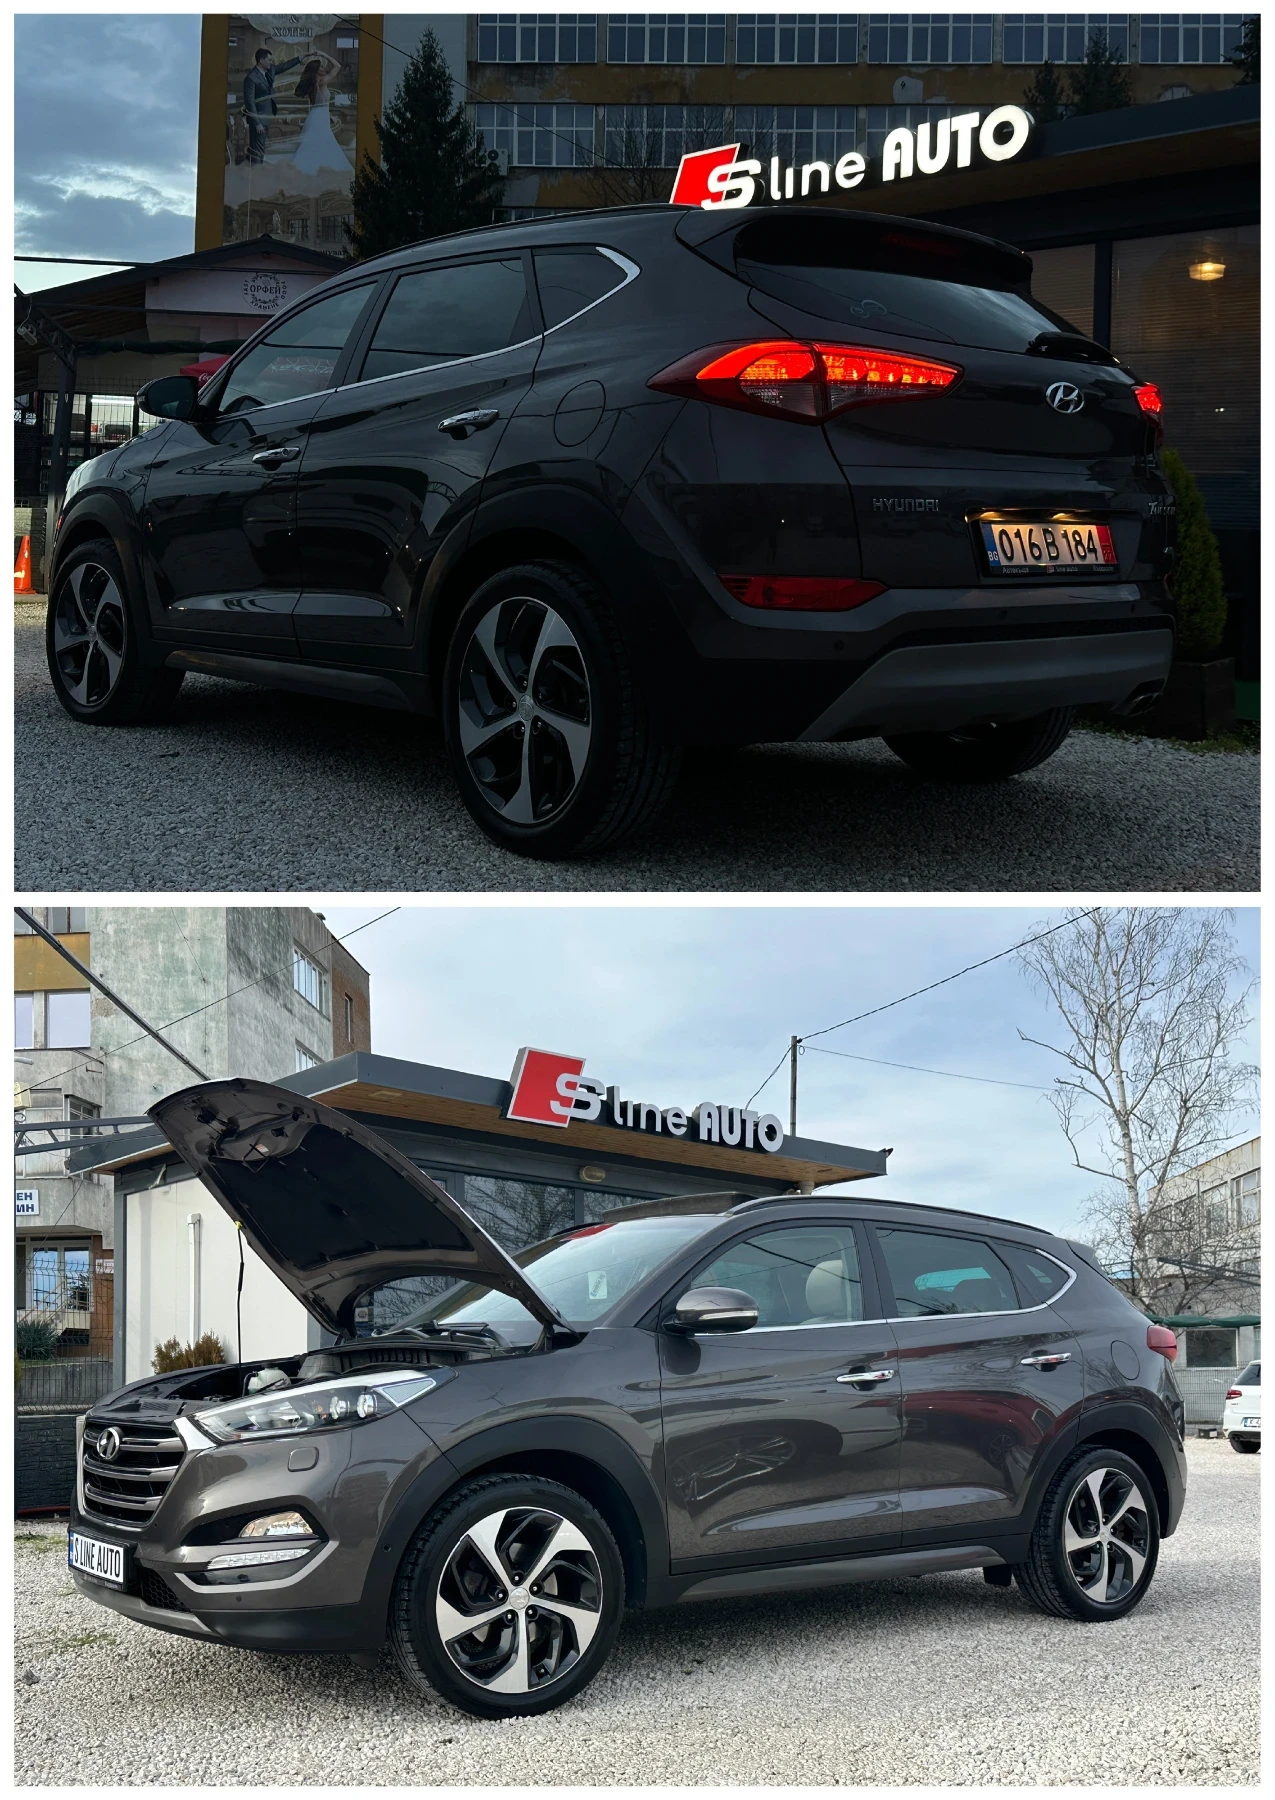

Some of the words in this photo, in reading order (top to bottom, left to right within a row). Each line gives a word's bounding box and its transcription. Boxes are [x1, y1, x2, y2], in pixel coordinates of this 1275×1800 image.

[770, 151, 865, 200] line
[882, 104, 1030, 182] AUTO
[250, 284, 281, 295] ОРФЕЙ
[872, 498, 939, 512] HYUNDAI
[987, 550, 999, 561] BG
[998, 528, 1043, 563] 016
[1060, 528, 1099, 562] 184
[550, 1073, 605, 1121] S
[610, 1086, 688, 1136] line
[697, 1102, 784, 1153] AUTO
[75, 1537, 79, 1564] S
[80, 1539, 95, 1570] LINE
[97, 1545, 121, 1578] AUTO
